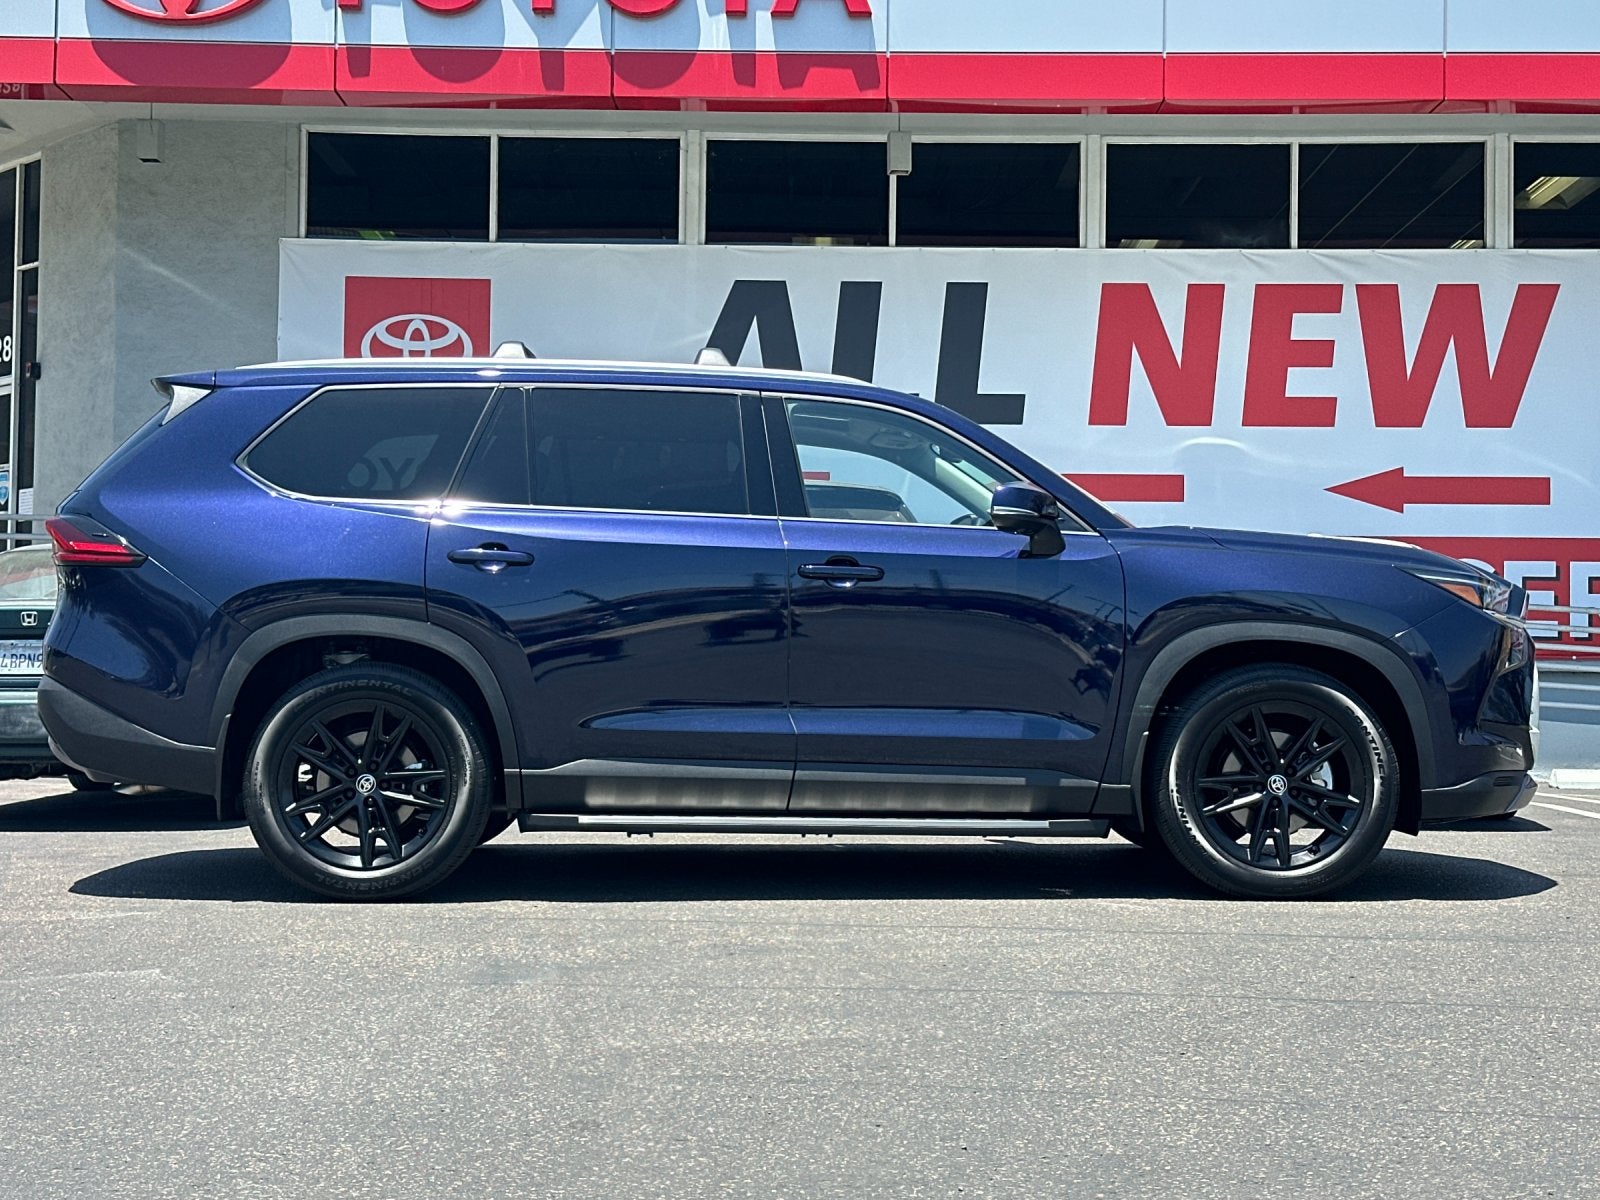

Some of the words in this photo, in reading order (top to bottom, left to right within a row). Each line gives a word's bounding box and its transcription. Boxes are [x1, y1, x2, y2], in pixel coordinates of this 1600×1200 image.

[0, 335, 11, 362] 8
[705, 279, 1025, 425] ALL
[1089, 282, 1561, 429] NEW
